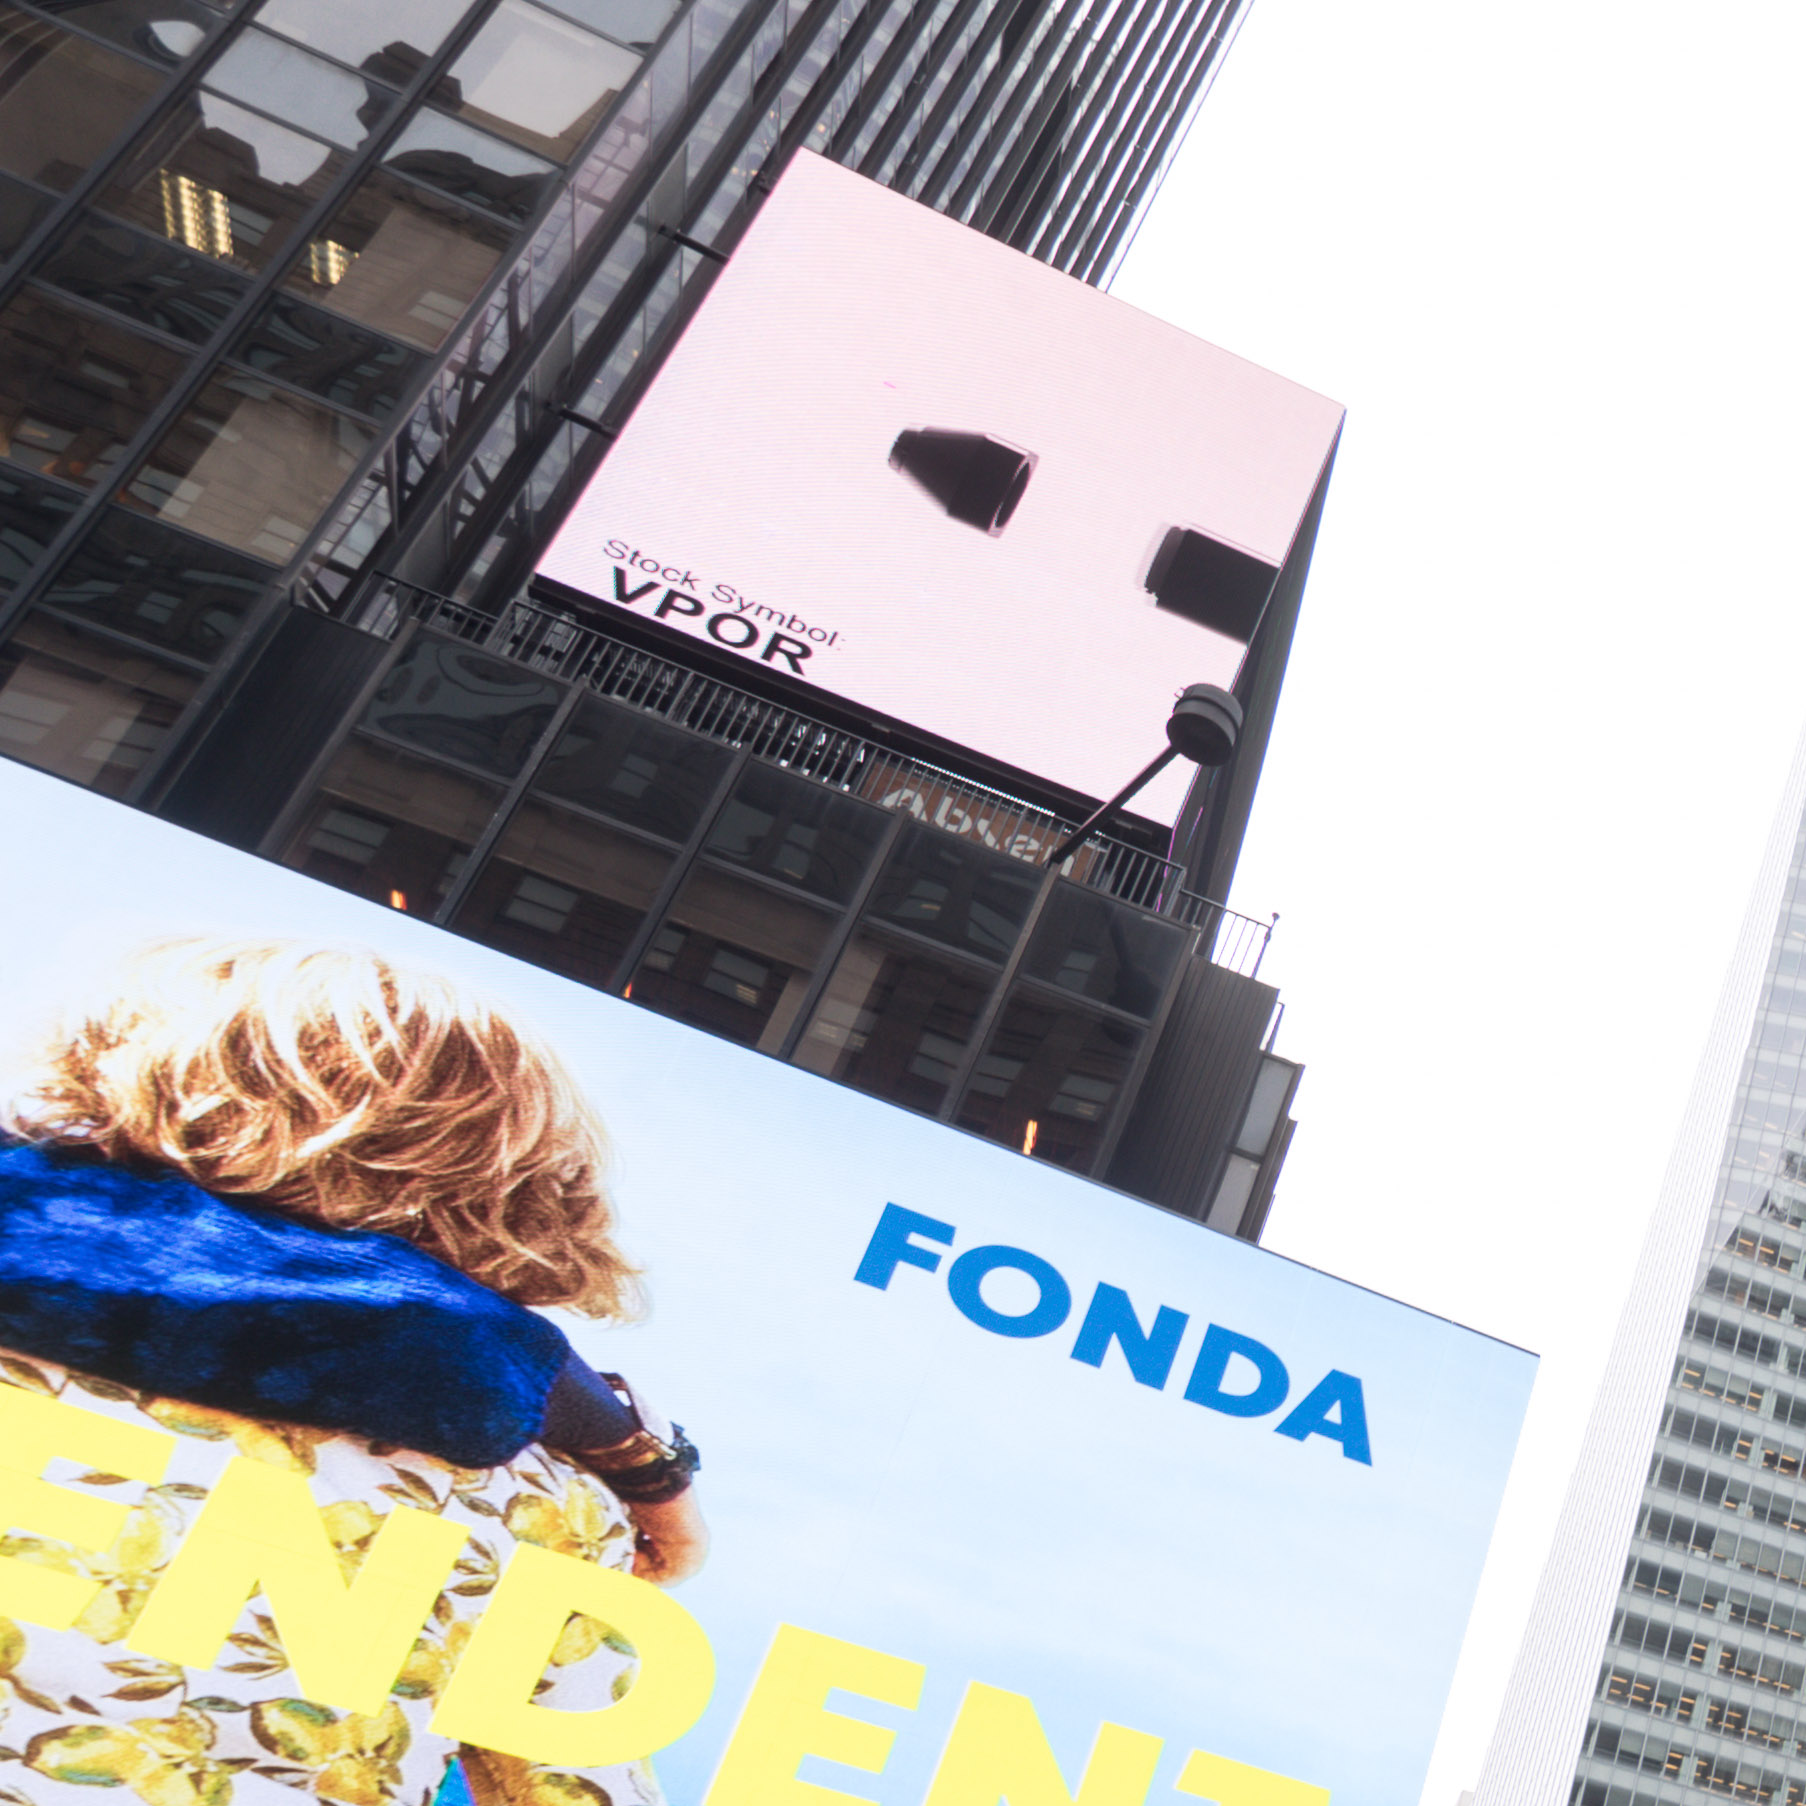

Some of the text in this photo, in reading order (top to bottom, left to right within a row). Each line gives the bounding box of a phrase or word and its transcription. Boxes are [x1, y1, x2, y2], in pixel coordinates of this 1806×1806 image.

[603, 540, 701, 590] Stock
[613, 566, 813, 676] VPOR
[854, 1200, 1375, 1468] FONDA
